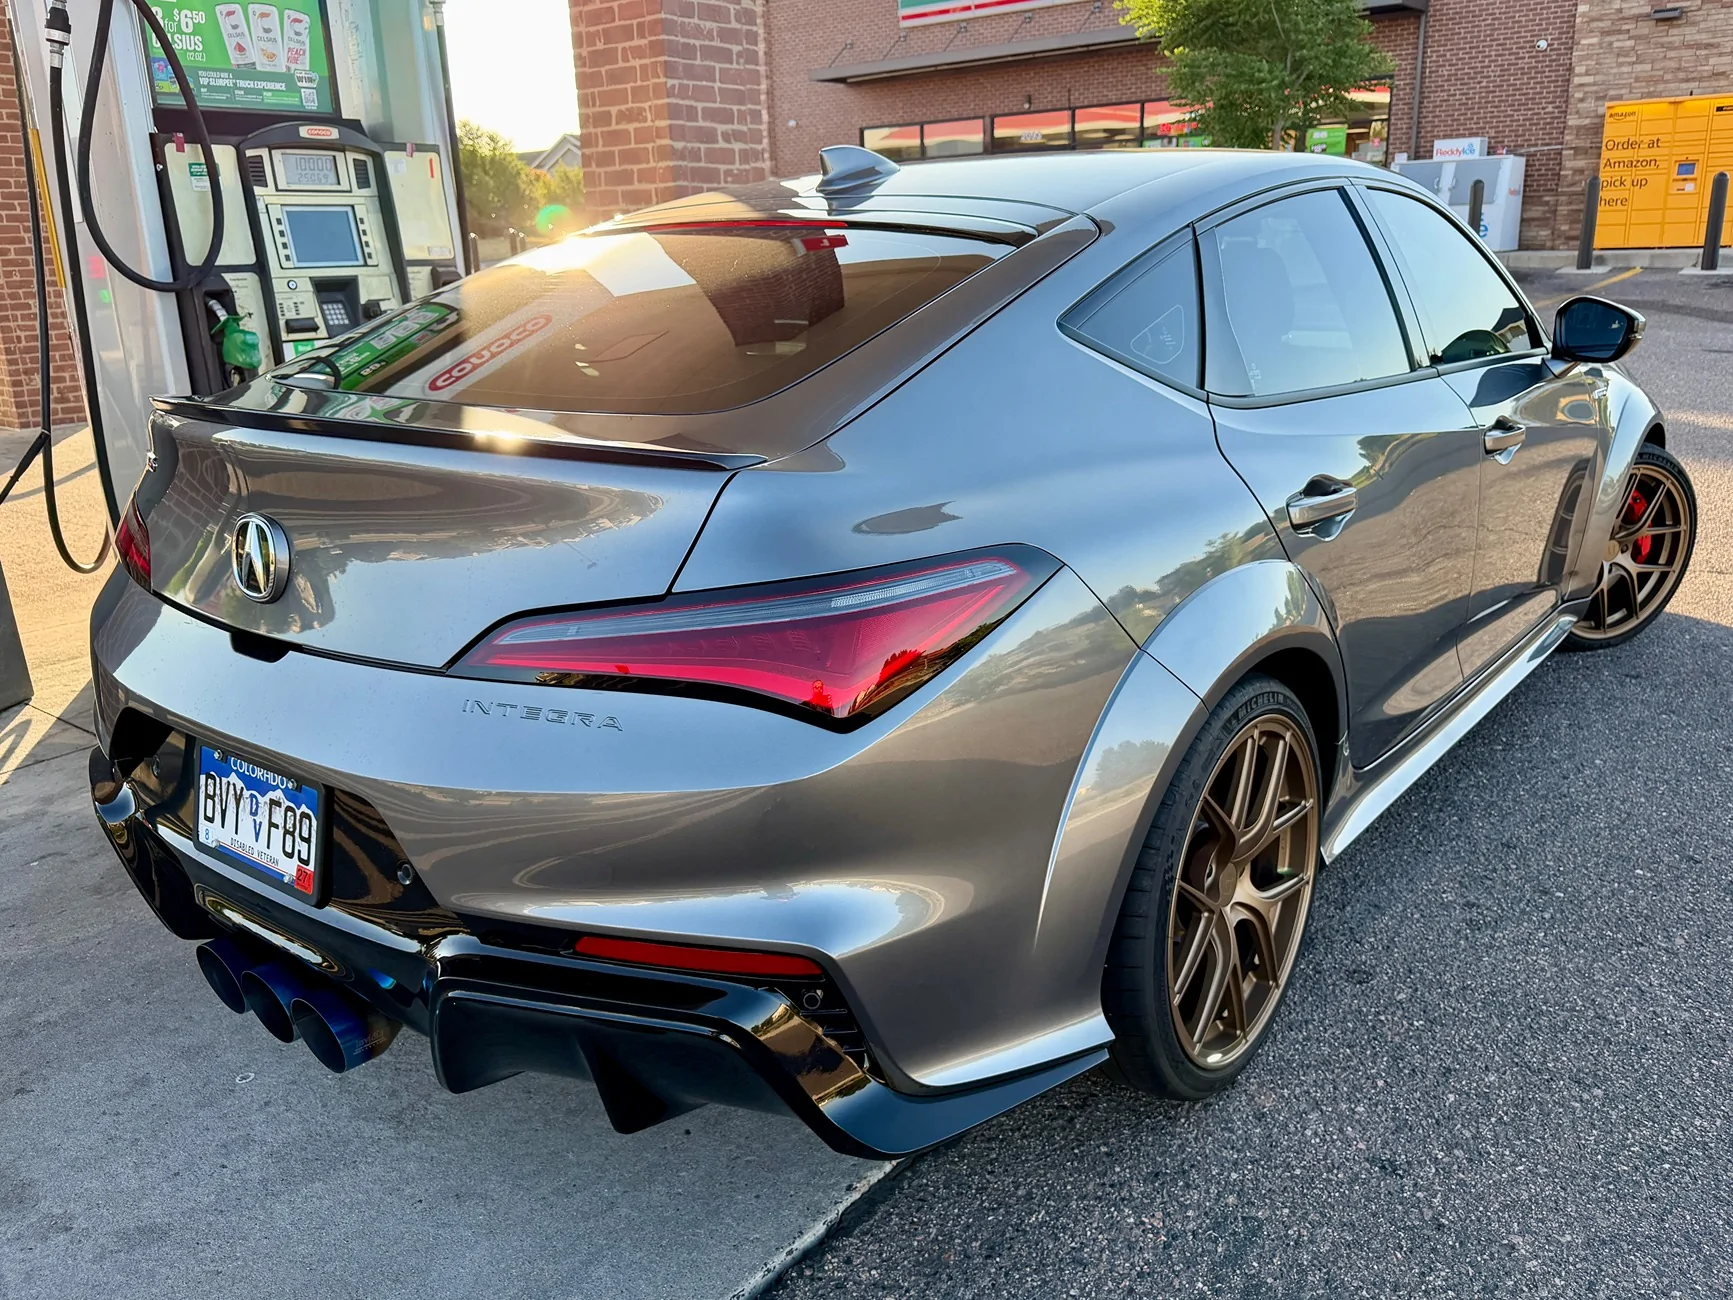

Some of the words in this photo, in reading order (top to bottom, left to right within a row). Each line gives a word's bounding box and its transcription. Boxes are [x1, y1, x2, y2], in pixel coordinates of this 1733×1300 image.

[164, 18, 178, 33] for
[151, 31, 203, 51] CLSIUS
[227, 31, 245, 39] CELSIUS
[257, 35, 277, 43] CELSIUS
[287, 47, 306, 57] PEACH
[287, 55, 300, 65] VIBE
[199, 77, 209, 86] VIP
[236, 79, 254, 88] TRUCK
[254, 81, 286, 91] EXPERIENCE
[1608, 110, 1636, 119] amazon
[1605, 138, 1643, 151] Order
[1647, 137, 1661, 148] at
[1603, 157, 1660, 170] Amazon,
[1601, 176, 1627, 191] pick
[1630, 177, 1648, 190] up
[1599, 195, 1628, 207] here
[1238, 692, 1284, 719] MICHELIN
[462, 699, 623, 732] INTEGRA
[230, 756, 287, 789] COLORADO
[203, 772, 244, 836] BVY
[266, 797, 312, 867] F89
[230, 837, 254, 856] DISABLED
[257, 849, 280, 867] VETERAN
[297, 868, 308, 883] 27
